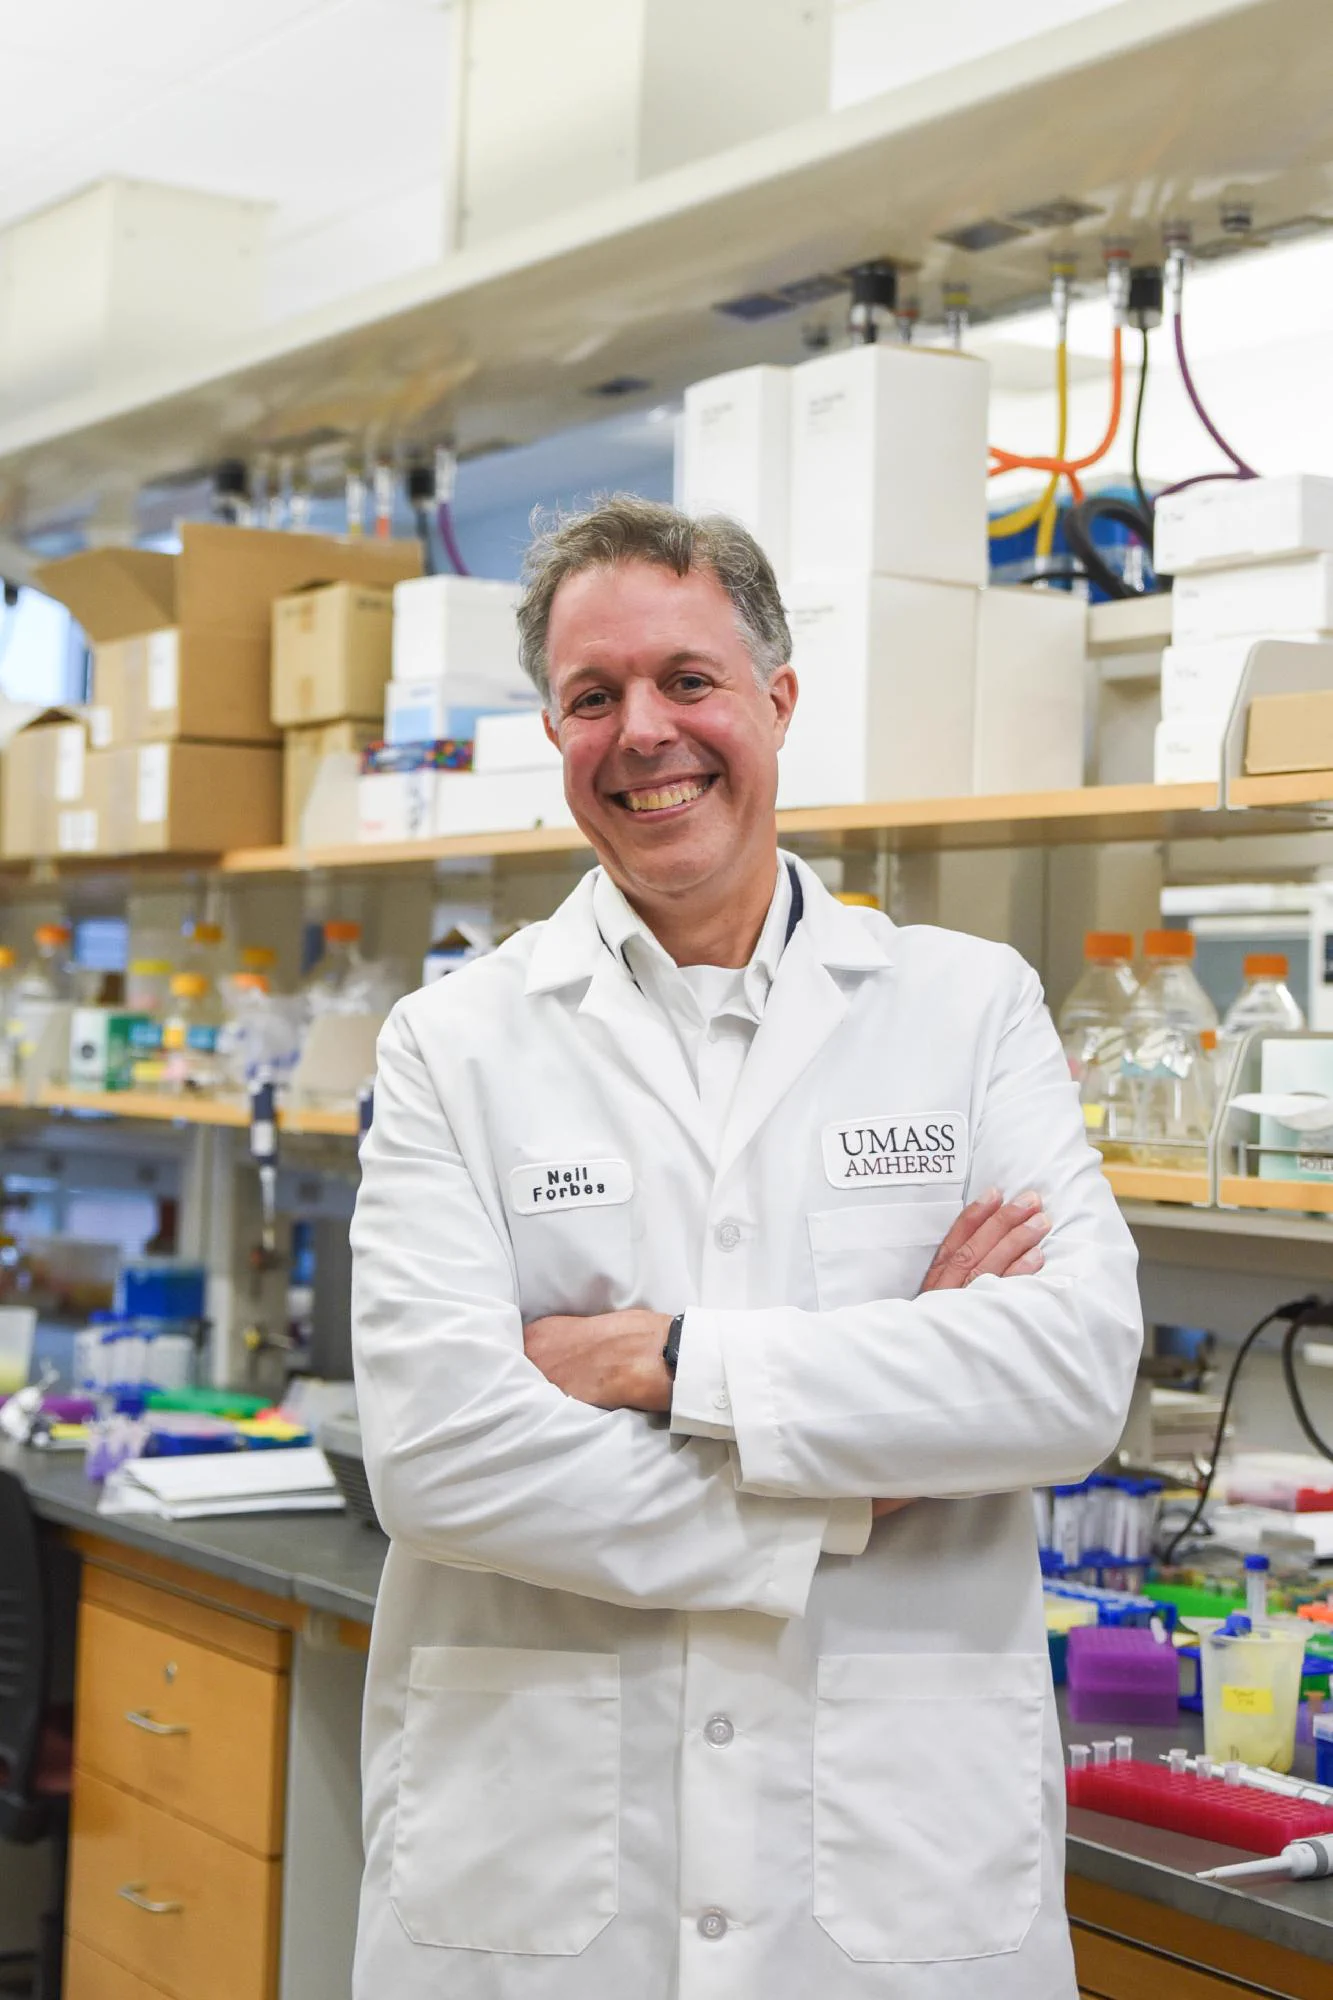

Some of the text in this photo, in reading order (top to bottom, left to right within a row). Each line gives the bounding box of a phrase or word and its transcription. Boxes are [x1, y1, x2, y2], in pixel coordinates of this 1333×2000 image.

[838, 1124, 955, 1156] UMASS
[547, 1167, 587, 1185] Neil
[844, 1154, 955, 1177] AMHERST
[533, 1183, 605, 1202] Forbes
